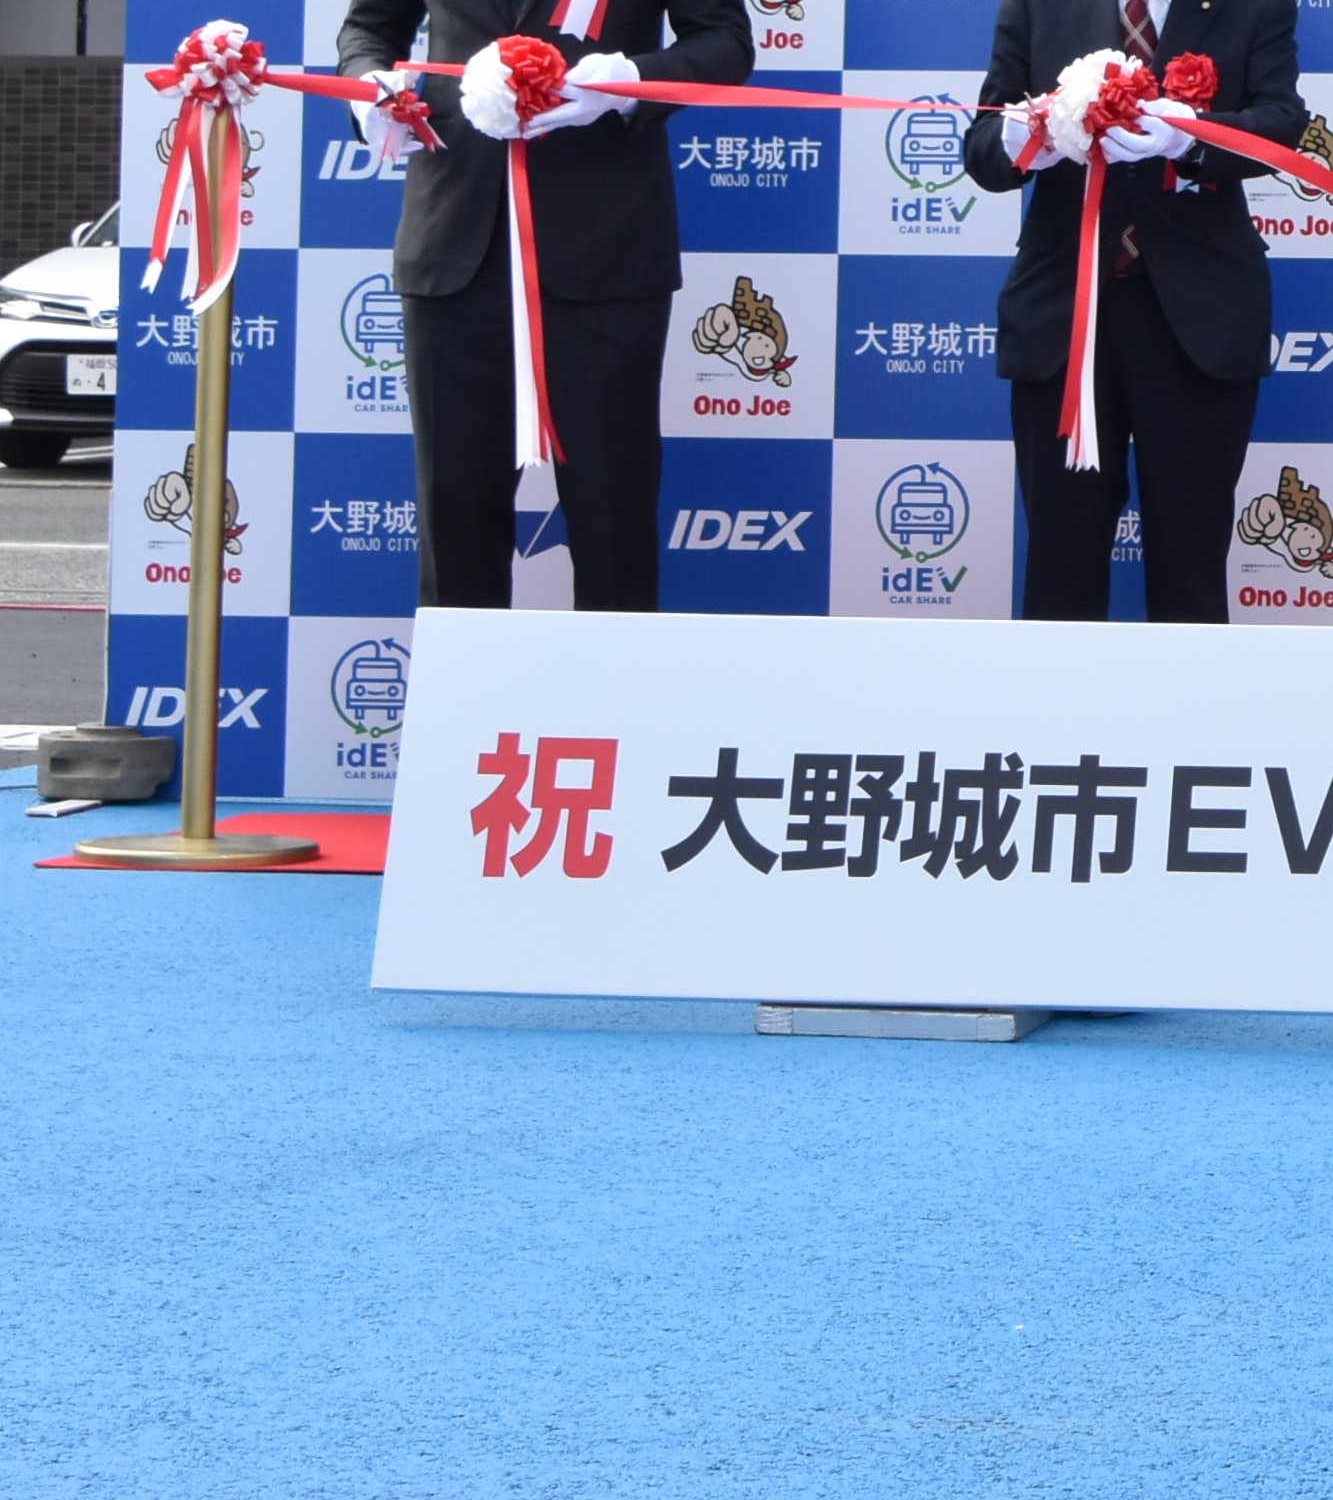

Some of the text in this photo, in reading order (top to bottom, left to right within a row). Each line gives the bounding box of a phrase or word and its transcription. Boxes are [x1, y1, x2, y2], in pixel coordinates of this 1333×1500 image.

[761, 30, 804, 49] Joe
[679, 136, 821, 170] 大野城市
[711, 173, 788, 187] ONOJO CITY
[899, 226, 960, 234] CAR SHARE
[855, 322, 997, 357] 大野城市
[887, 360, 964, 373] ONOJO CITY
[694, 395, 792, 417] Ono Joe
[668, 510, 812, 550] IDEX
[917, 596, 951, 604] SHARE
[1238, 586, 1288, 607] Ono
[470, 732, 619, 878] 祝
